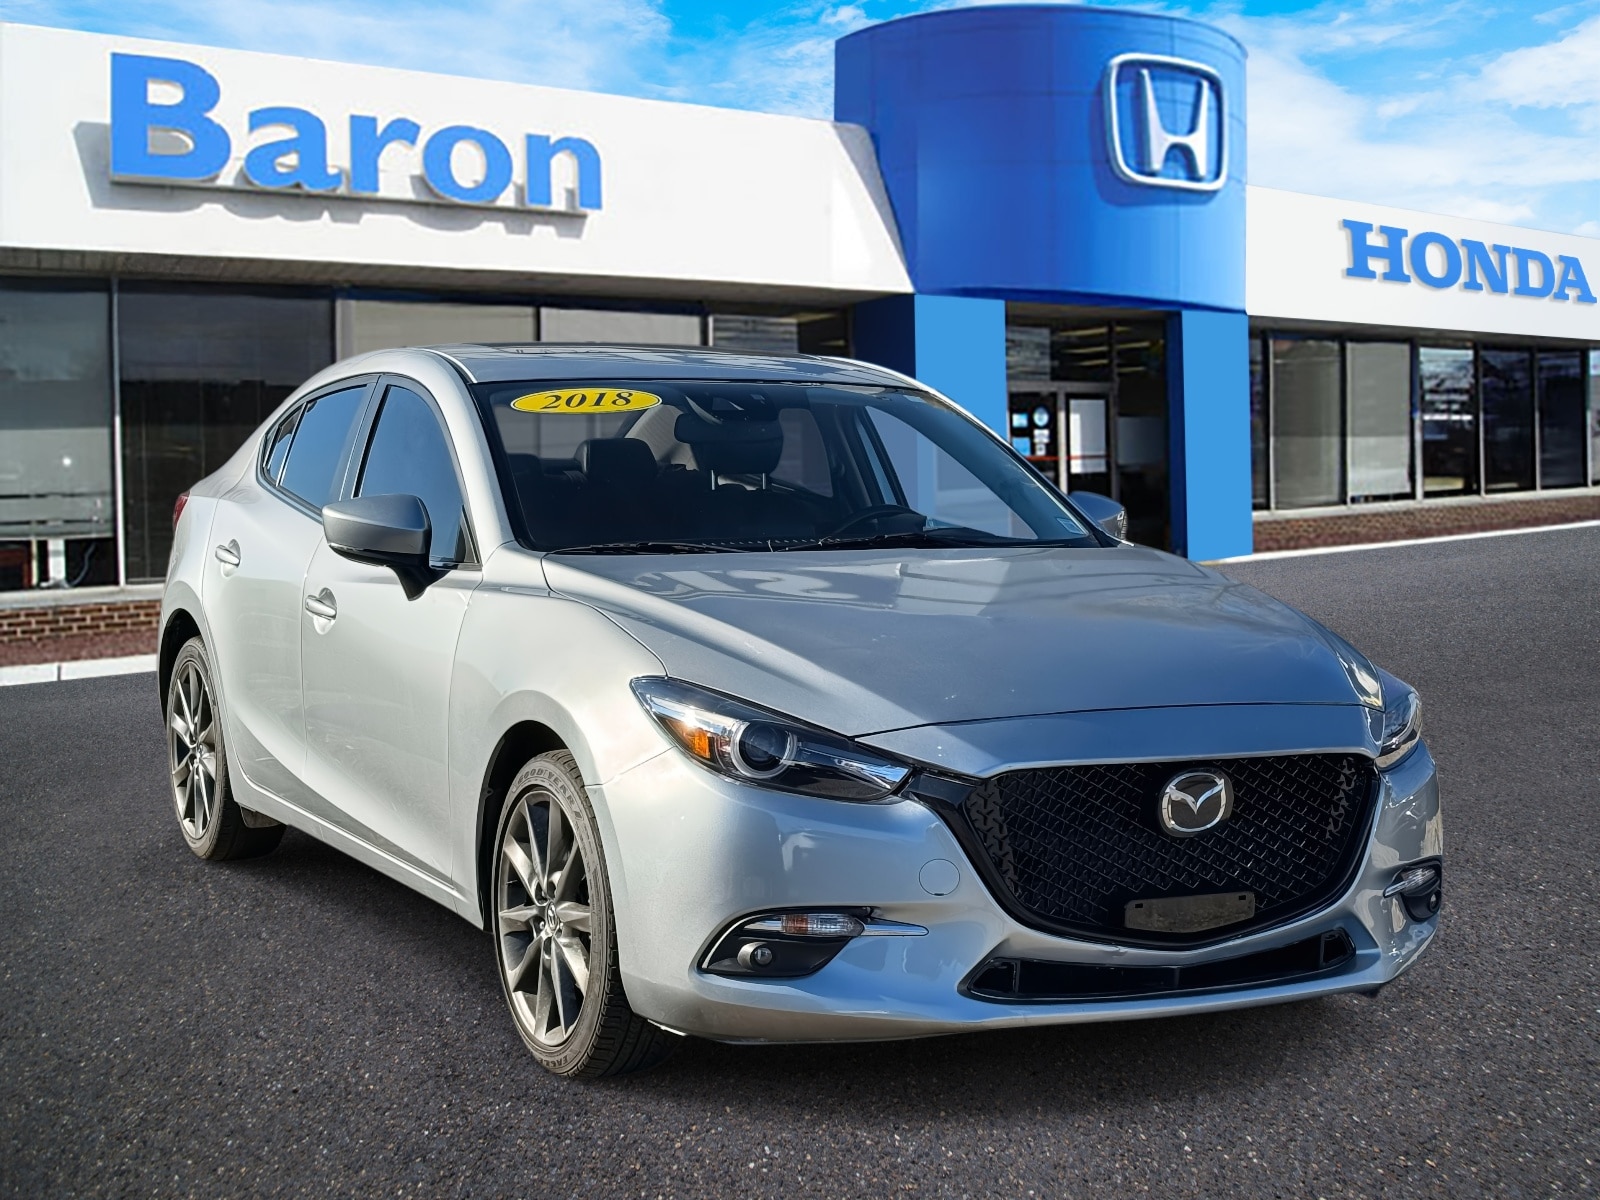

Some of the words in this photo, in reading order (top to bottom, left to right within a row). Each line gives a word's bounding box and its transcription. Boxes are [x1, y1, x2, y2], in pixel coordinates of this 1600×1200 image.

[109, 51, 603, 211] Baron
[1342, 218, 1598, 304] HONDA
[540, 391, 634, 410] 2018
[517, 768, 576, 806] GOODYEAR
